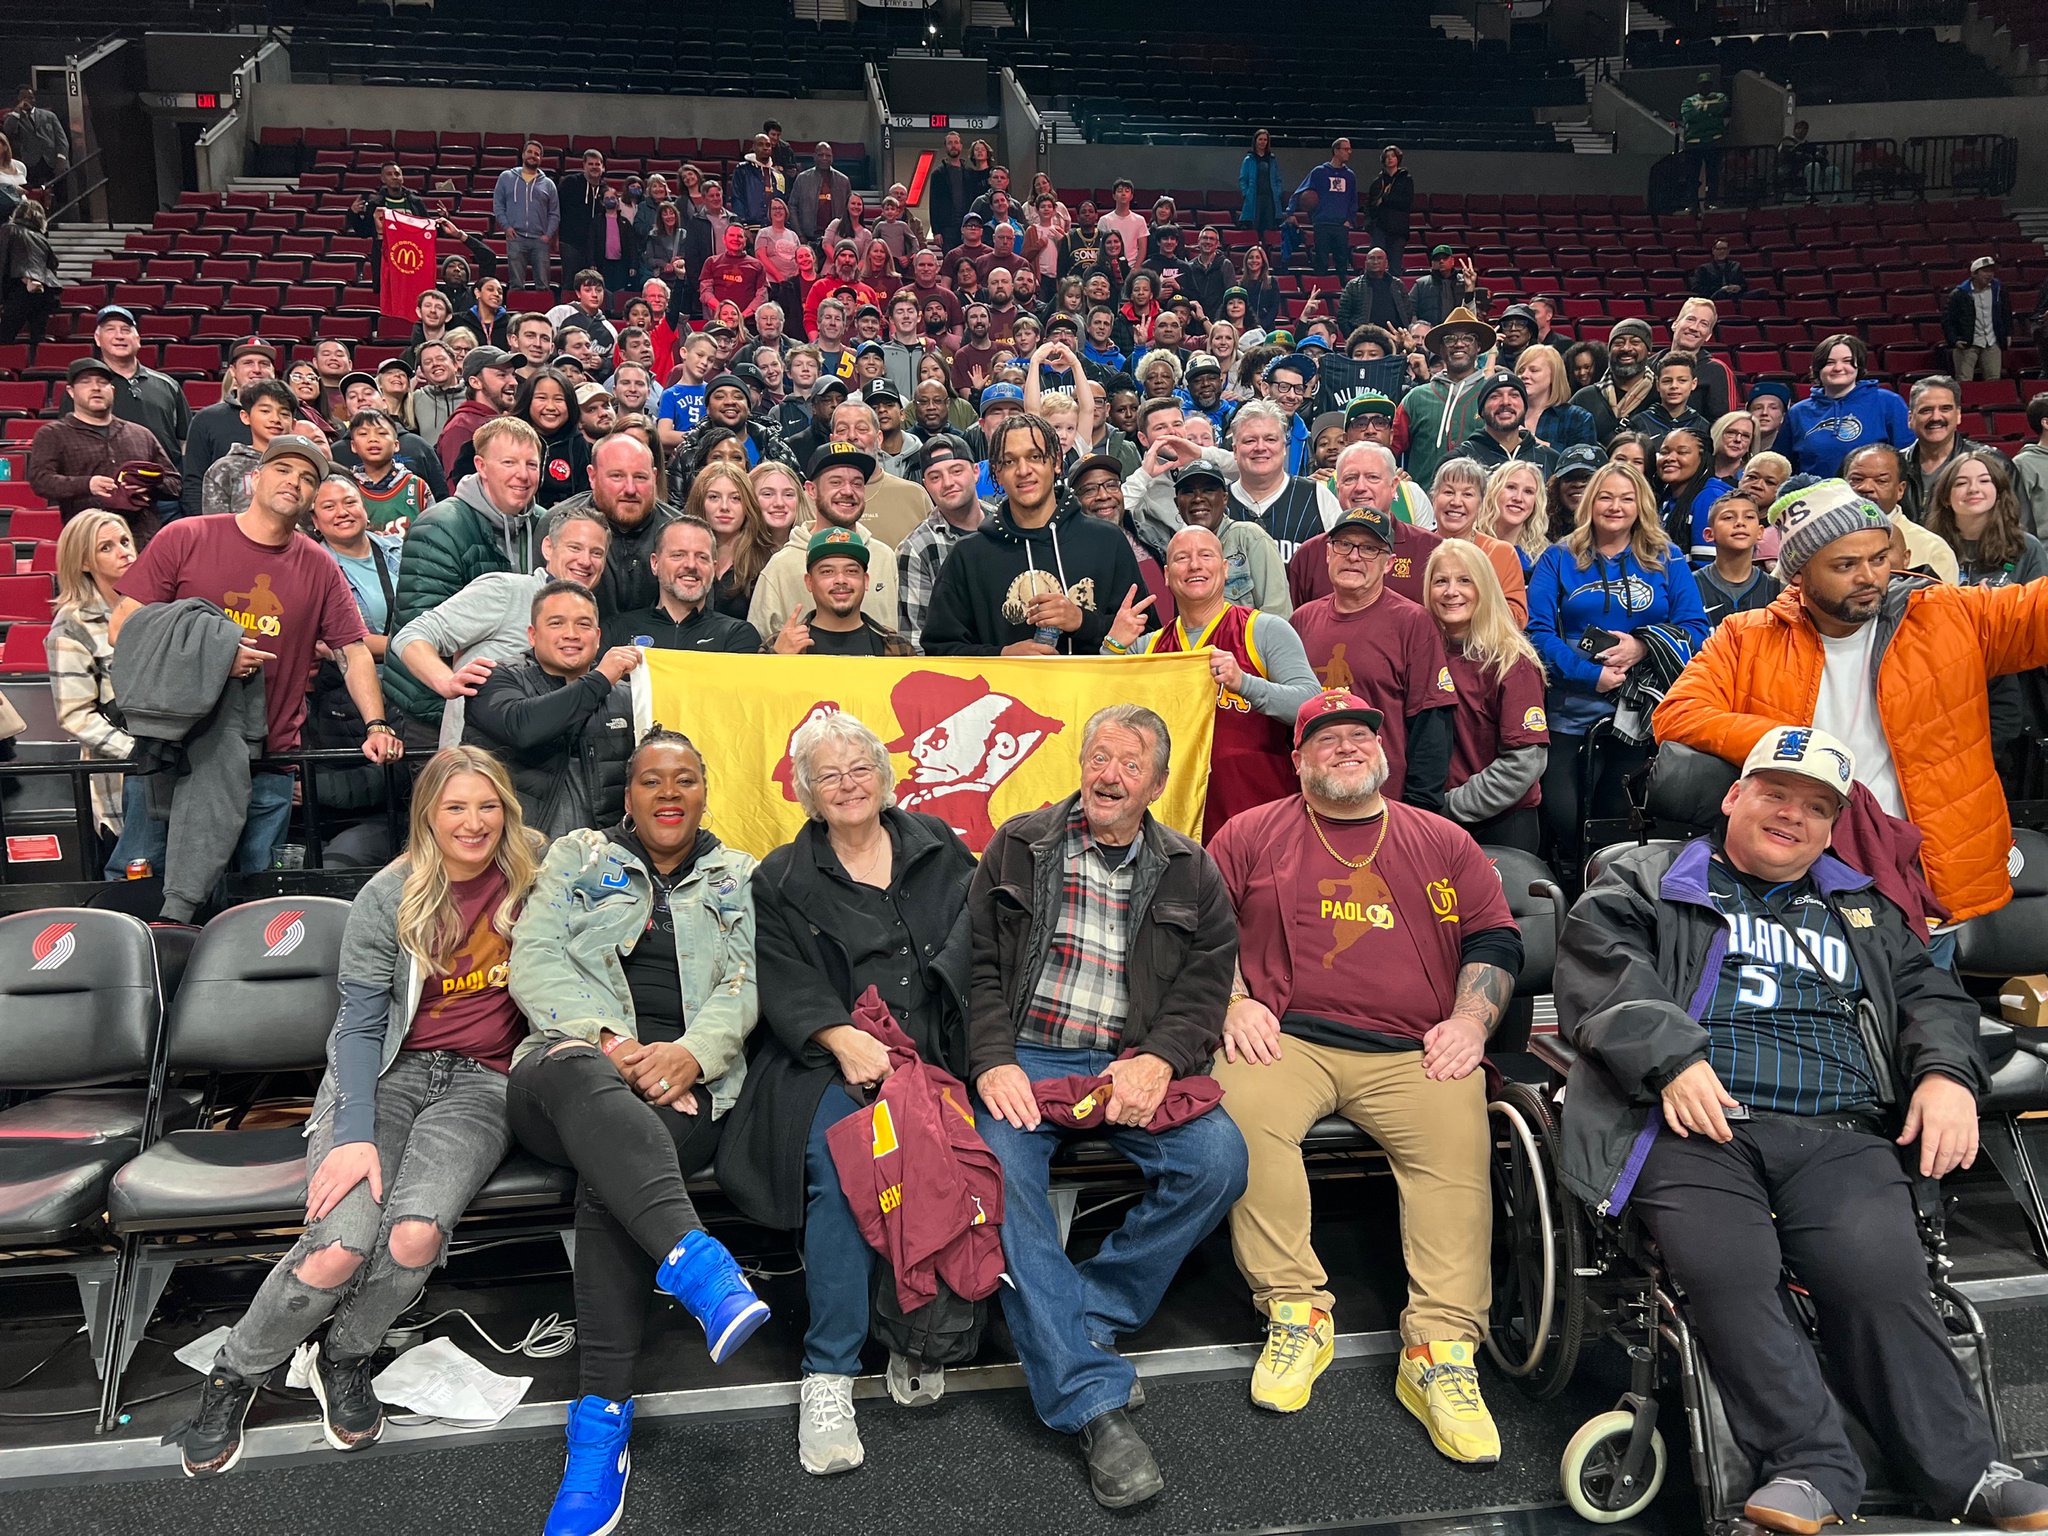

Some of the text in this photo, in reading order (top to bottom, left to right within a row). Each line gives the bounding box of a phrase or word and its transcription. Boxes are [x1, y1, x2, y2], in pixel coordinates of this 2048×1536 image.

[197, 94, 216, 108] EXIT
[895, 114, 983, 129] 102 EXIT 103
[836, 350, 857, 379] 5
[872, 379, 885, 392] B
[676, 394, 704, 410] DUK
[1333, 387, 1351, 407] ALL
[688, 407, 700, 423] 5
[1839, 906, 1877, 929] W
[1723, 913, 1847, 983] RLANDO
[1738, 964, 1778, 1008] 5
